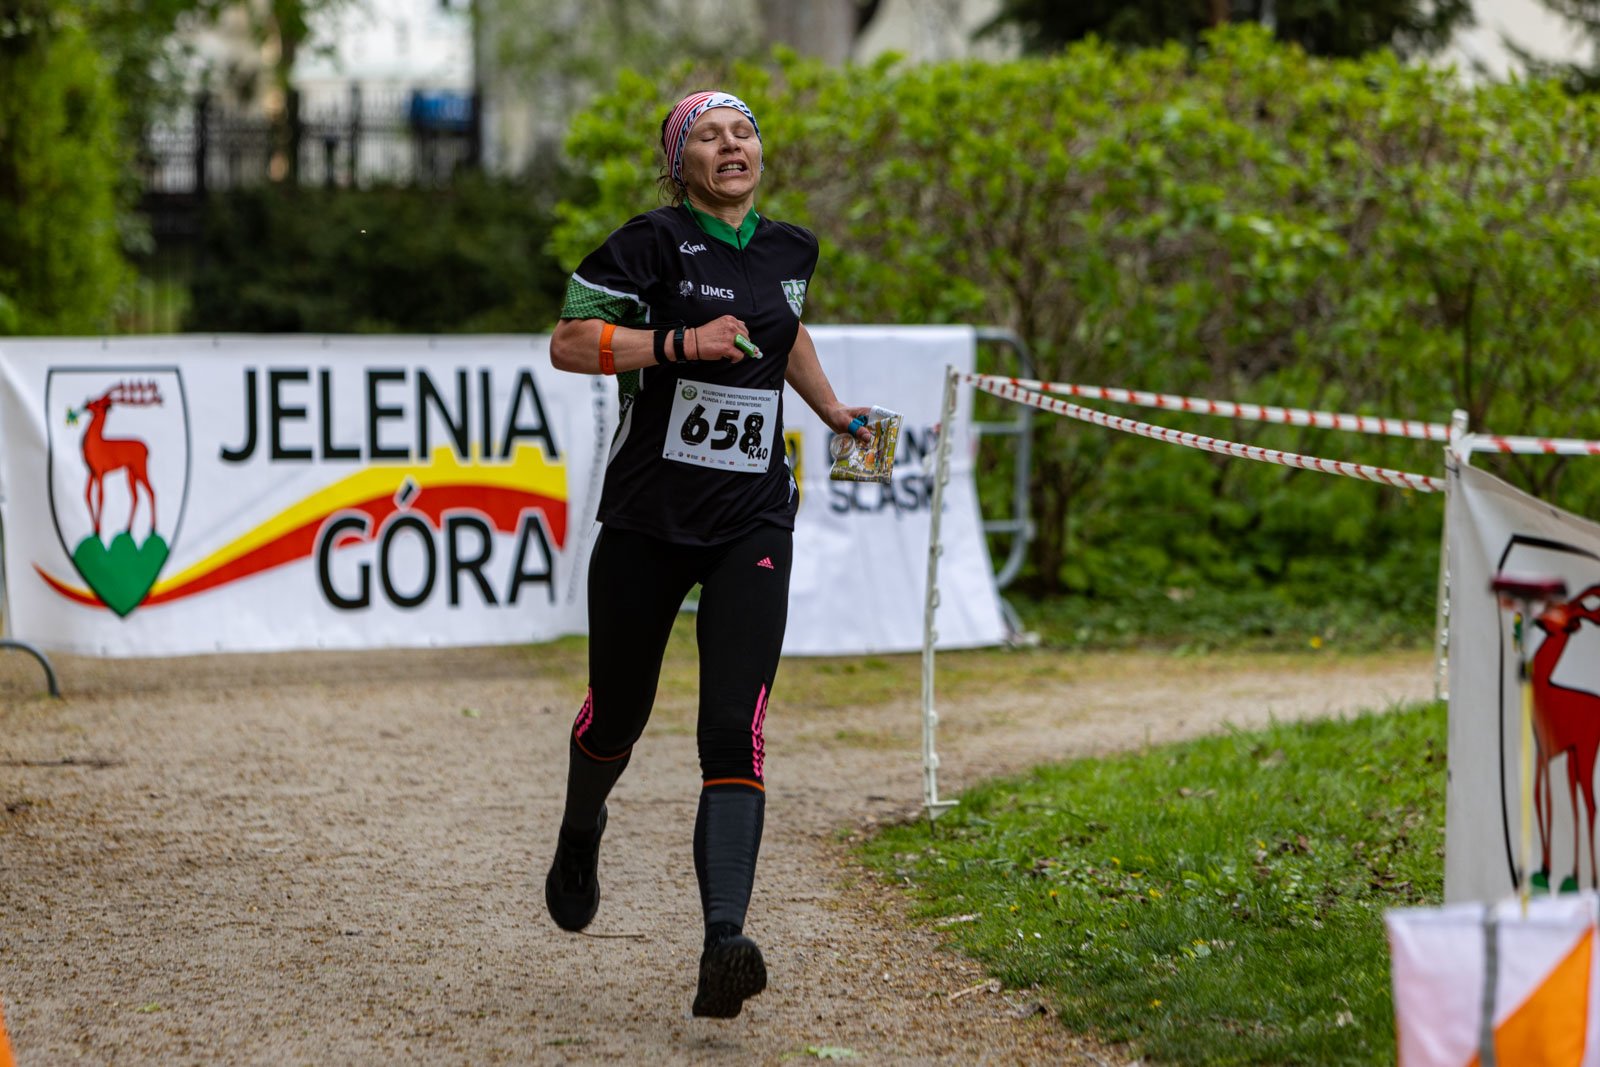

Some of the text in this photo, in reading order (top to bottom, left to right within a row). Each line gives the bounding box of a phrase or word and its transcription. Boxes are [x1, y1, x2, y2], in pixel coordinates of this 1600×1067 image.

[700, 284, 735, 299] UMCS
[219, 368, 559, 463] JELENIA
[680, 403, 764, 455] 658
[747, 445, 769, 461] K40
[317, 477, 557, 610] GÓRA
